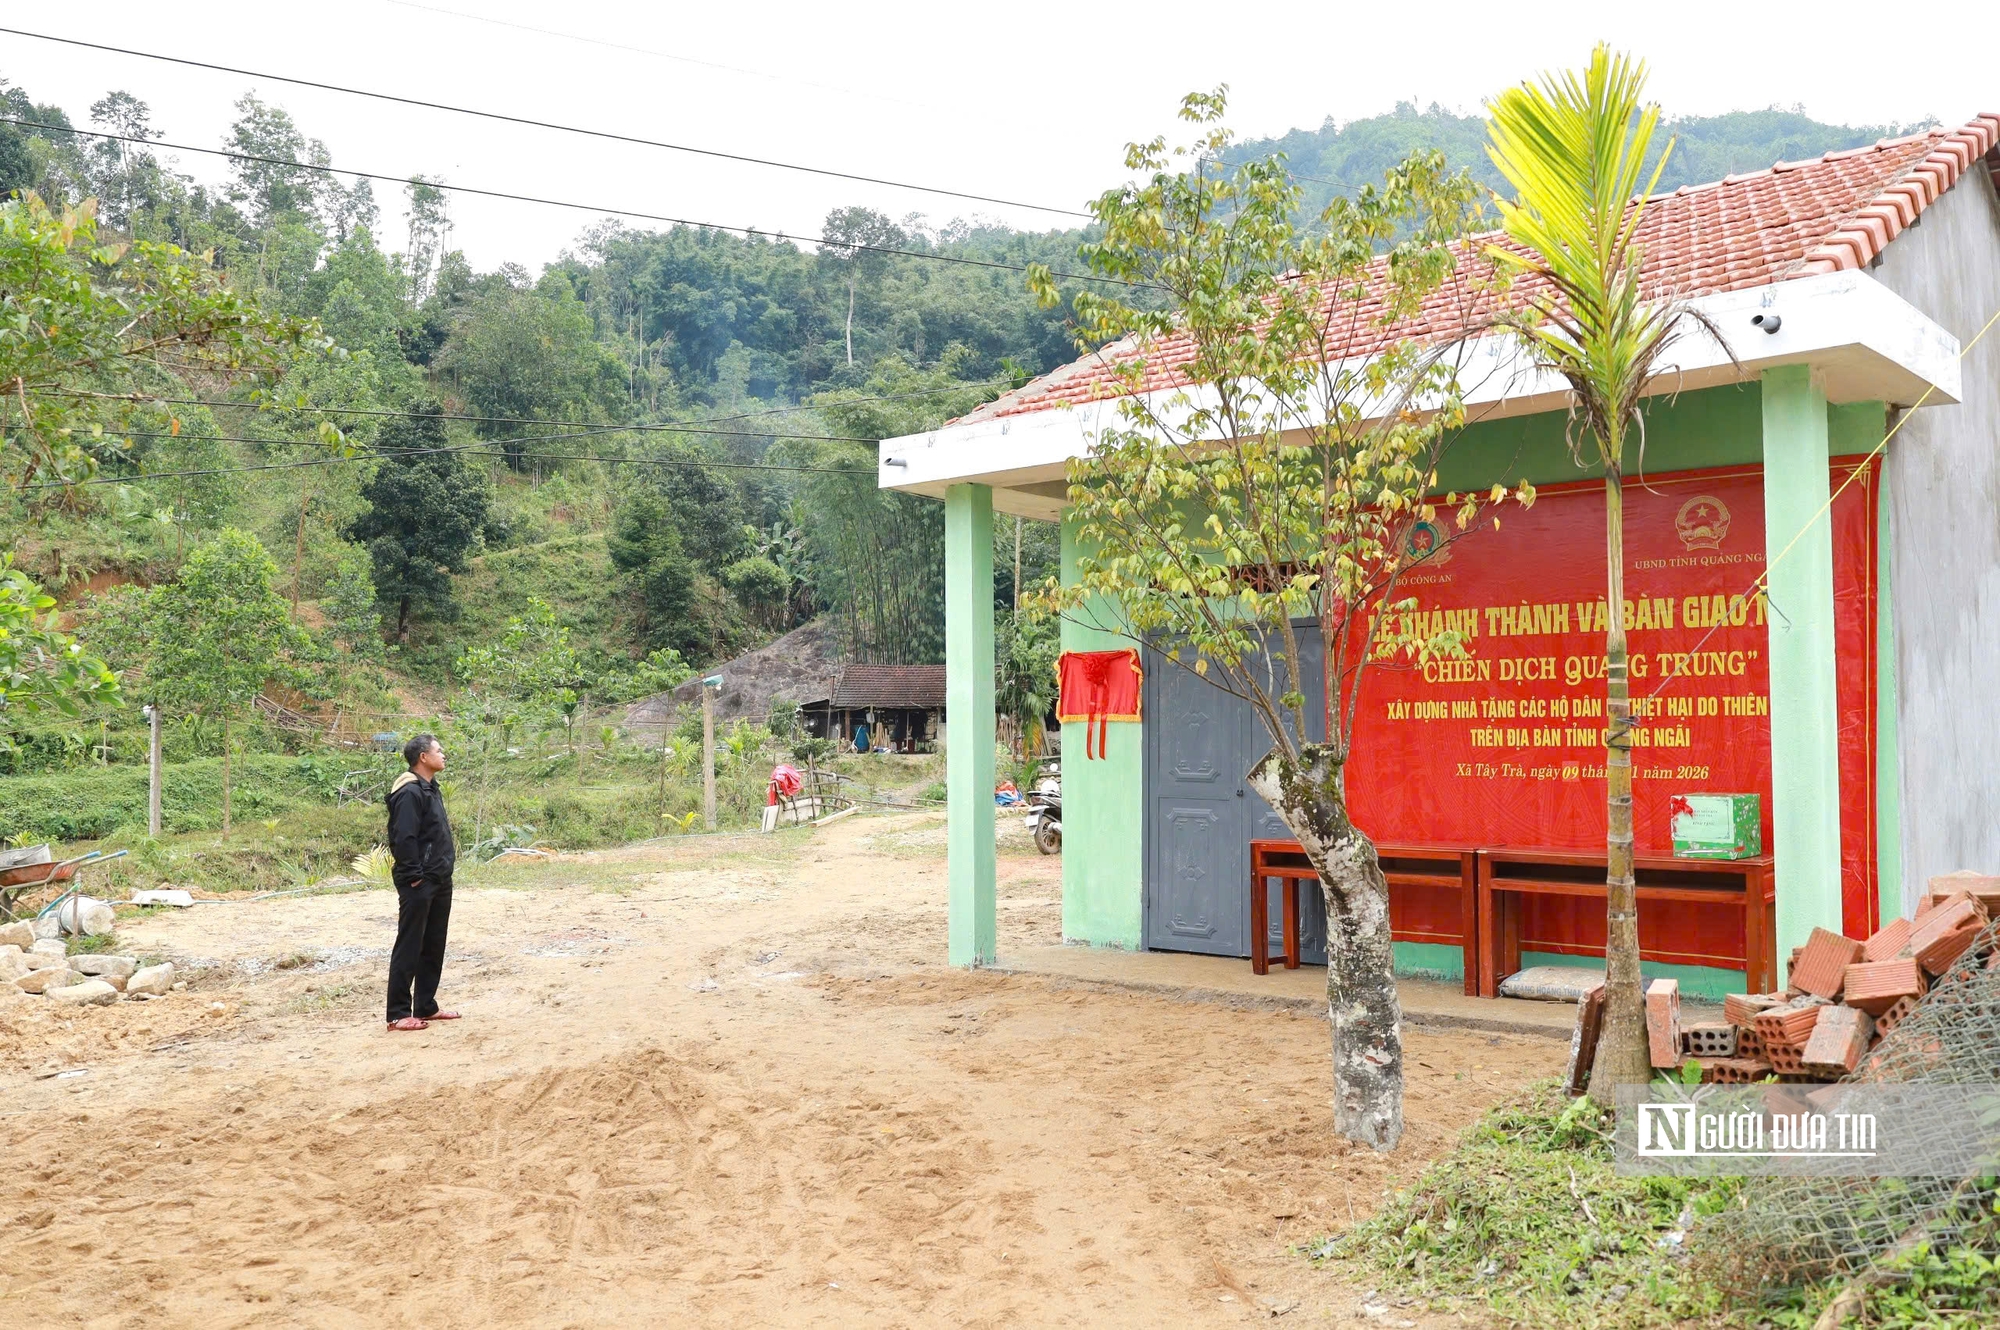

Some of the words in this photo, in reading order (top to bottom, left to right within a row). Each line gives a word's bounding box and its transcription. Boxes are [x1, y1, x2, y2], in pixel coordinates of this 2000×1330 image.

[1635, 558, 1667, 570] UBND
[1700, 552, 1742, 567] QUẢNG
[1410, 574, 1438, 585] CÔNG
[1439, 574, 1452, 583] AN
[1484, 599, 1570, 637] THÀNH
[1576, 595, 1609, 633] VÀ
[1622, 592, 1674, 631] BÀN
[1682, 594, 1747, 629] GIAO
[1499, 657, 1557, 685] DỊCH
[1564, 654, 1648, 686] QUG
[1387, 698, 1411, 720] XÂY
[1414, 700, 1448, 722] DỰNG
[1451, 698, 1478, 719] NHÀ
[1481, 697, 1515, 722] TẶNG
[1519, 696, 1546, 718] CÁC
[1550, 695, 1569, 721] HỘ
[1572, 695, 1602, 717] DÂN
[1667, 697, 1693, 720] HẠI
[1697, 697, 1718, 716] DO
[1722, 692, 1768, 716] THIÊN
[1470, 725, 1503, 747] TRÊN
[1507, 728, 1529, 750] ĐỊA
[1533, 725, 1560, 747] BÀN
[1565, 723, 1597, 747] TỈNH
[1601, 728, 1650, 749] QNG
[1653, 724, 1691, 747] NGÃI
[1456, 763, 1472, 777] Xã
[1475, 763, 1498, 781] Tây
[1501, 763, 1527, 779] Trà,
[1530, 763, 1560, 781] ngày
[1562, 765, 1579, 779] 09
[1643, 765, 1673, 779] năm
[1675, 765, 1709, 779] 2026
